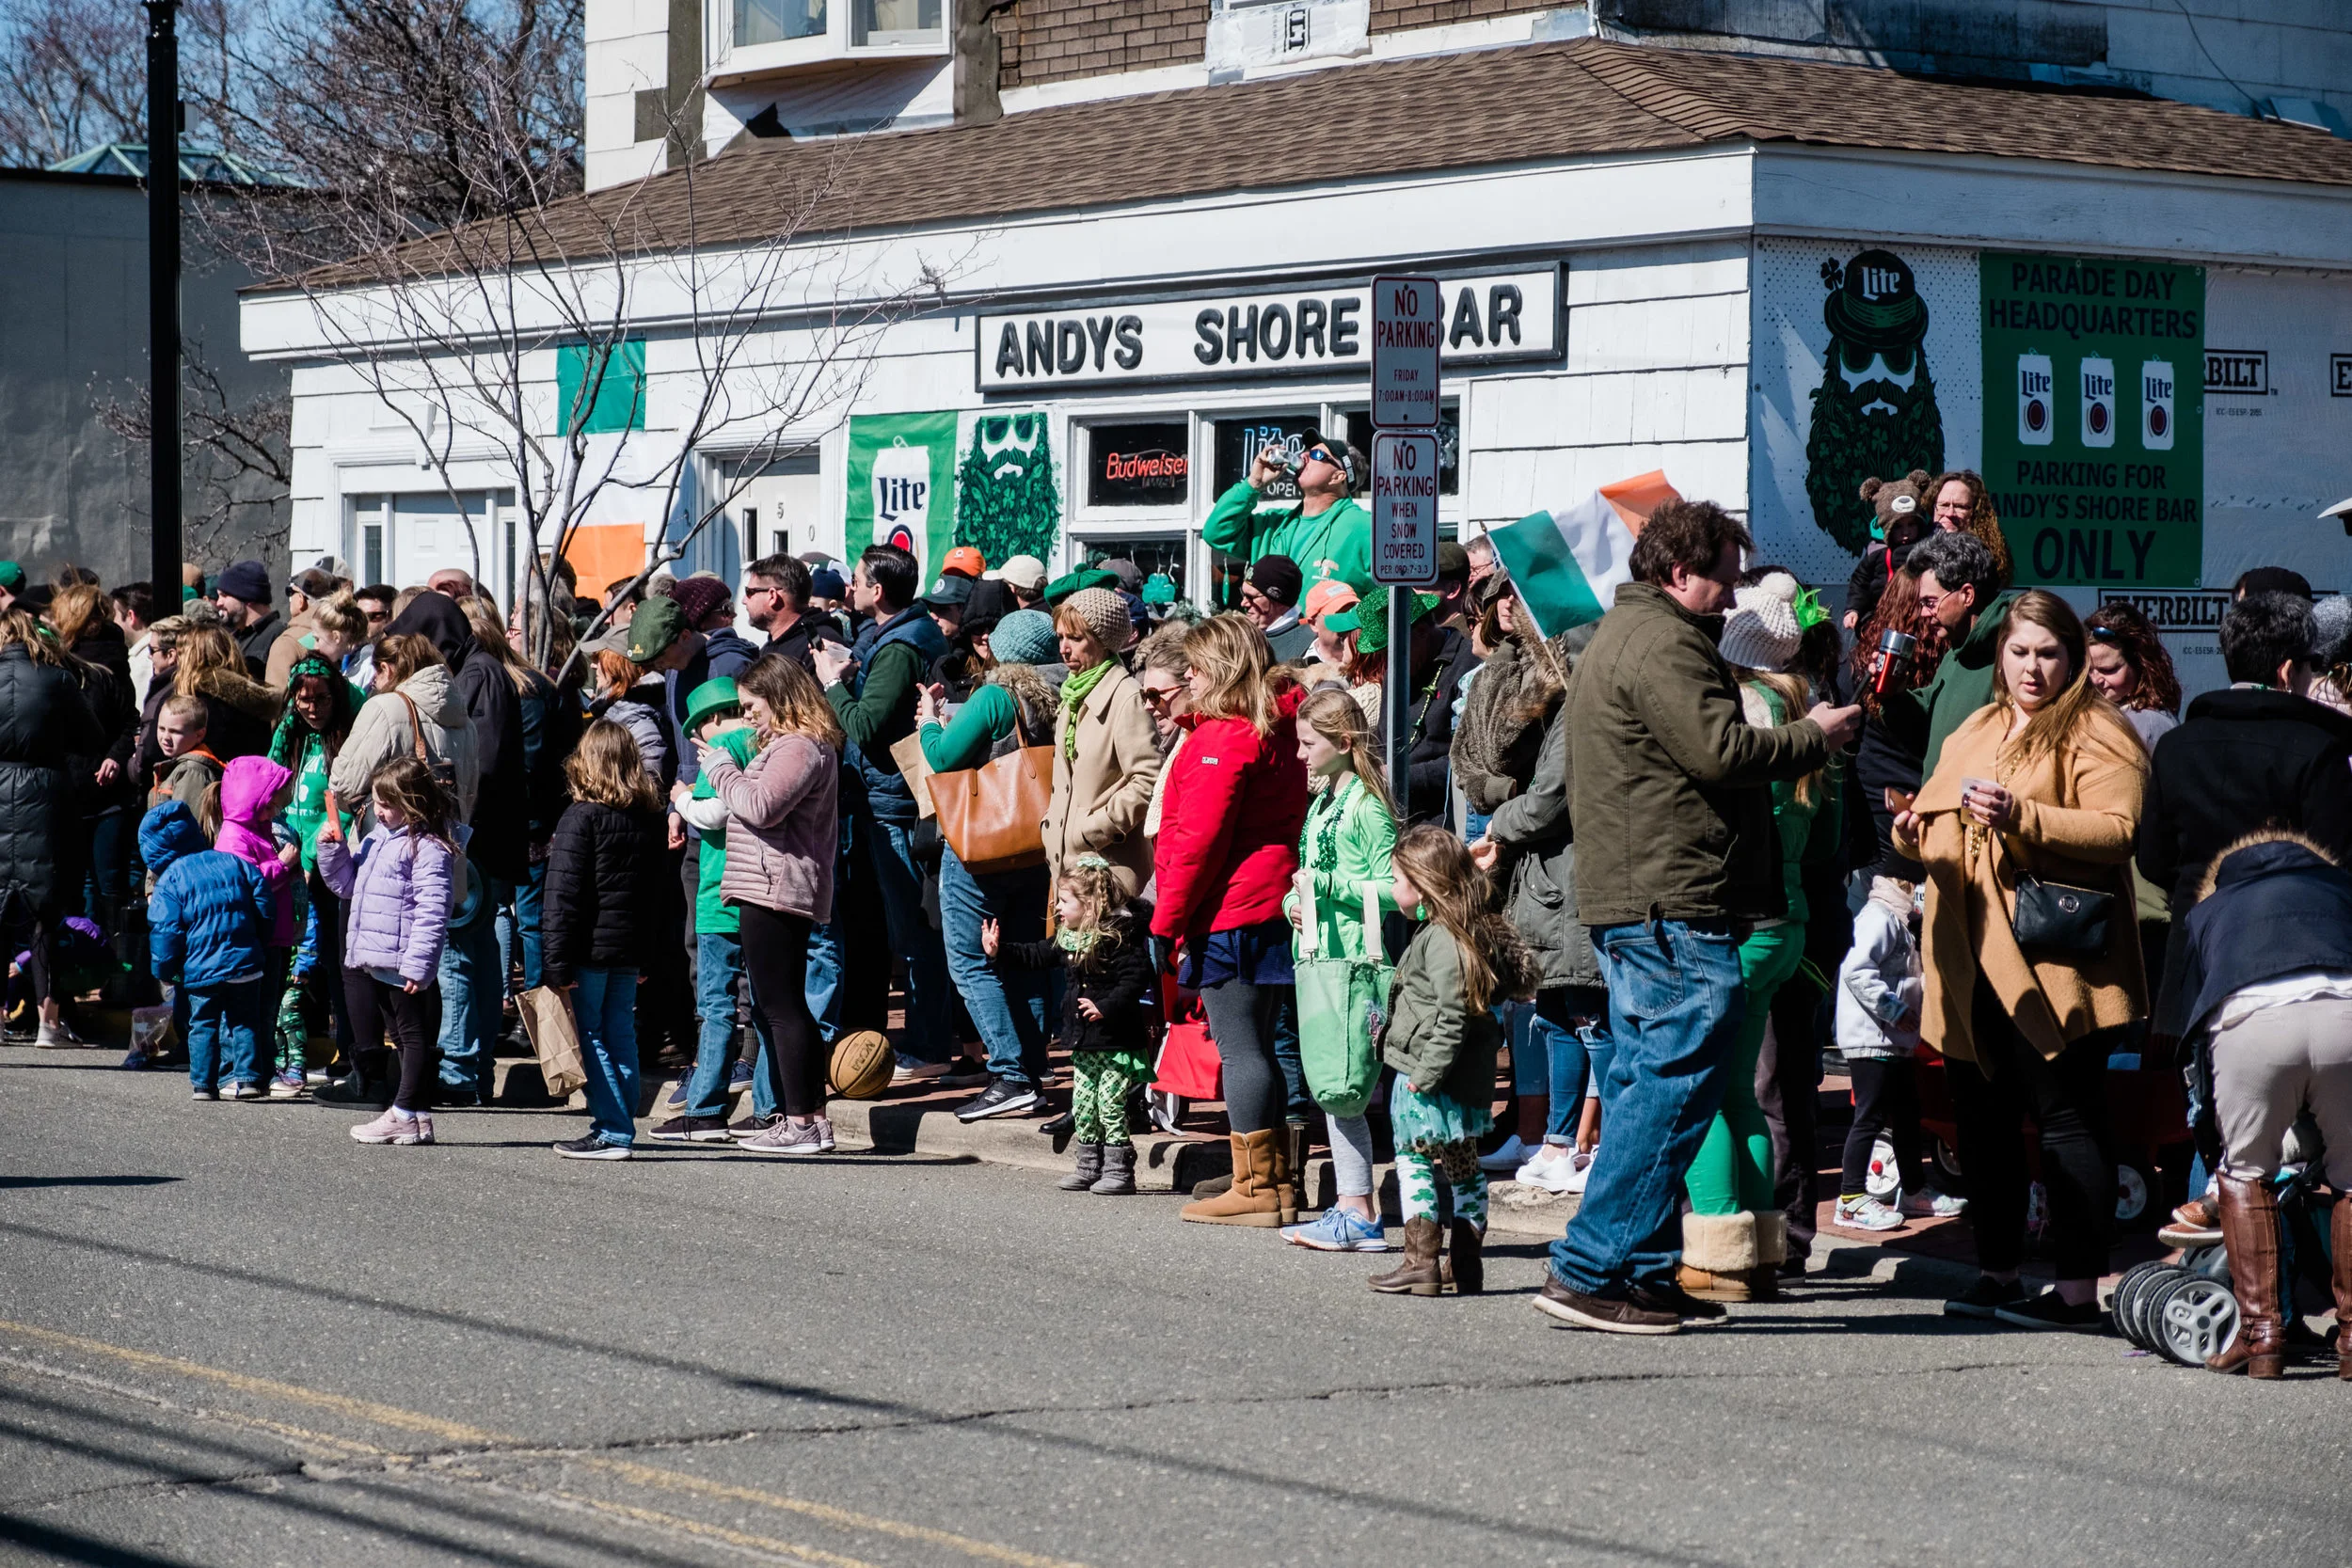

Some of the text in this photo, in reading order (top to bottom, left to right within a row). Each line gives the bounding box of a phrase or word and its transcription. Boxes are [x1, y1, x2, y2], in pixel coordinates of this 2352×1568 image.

[1862, 266, 1900, 300] Lite
[2012, 262, 2176, 300] PARADE DAY
[1394, 290, 1418, 316] NO
[995, 283, 1523, 378] ANDYS SHORE AR
[1989, 298, 2197, 340] HEADQUARTERS
[1377, 321, 1435, 348] PARKING
[1393, 369, 1419, 382] FRIDAY
[2021, 371, 2051, 398] Lite
[2203, 356, 2262, 387] BILT
[2084, 373, 2113, 401] Lite
[2145, 377, 2172, 404] Lite
[1393, 444, 1416, 470] NO
[1377, 476, 1433, 497] PARKING
[2017, 460, 2167, 489] PARKING FOR
[876, 477, 926, 522] Lite
[1391, 502, 1418, 517] WHEN
[2074, 495, 2149, 521] SHORE
[2155, 498, 2198, 523] BAR
[1391, 523, 1417, 538] SNOW
[1383, 543, 1424, 559] COVERED
[2032, 527, 2156, 580] ONLY
[2105, 594, 2230, 626] VERBILT
